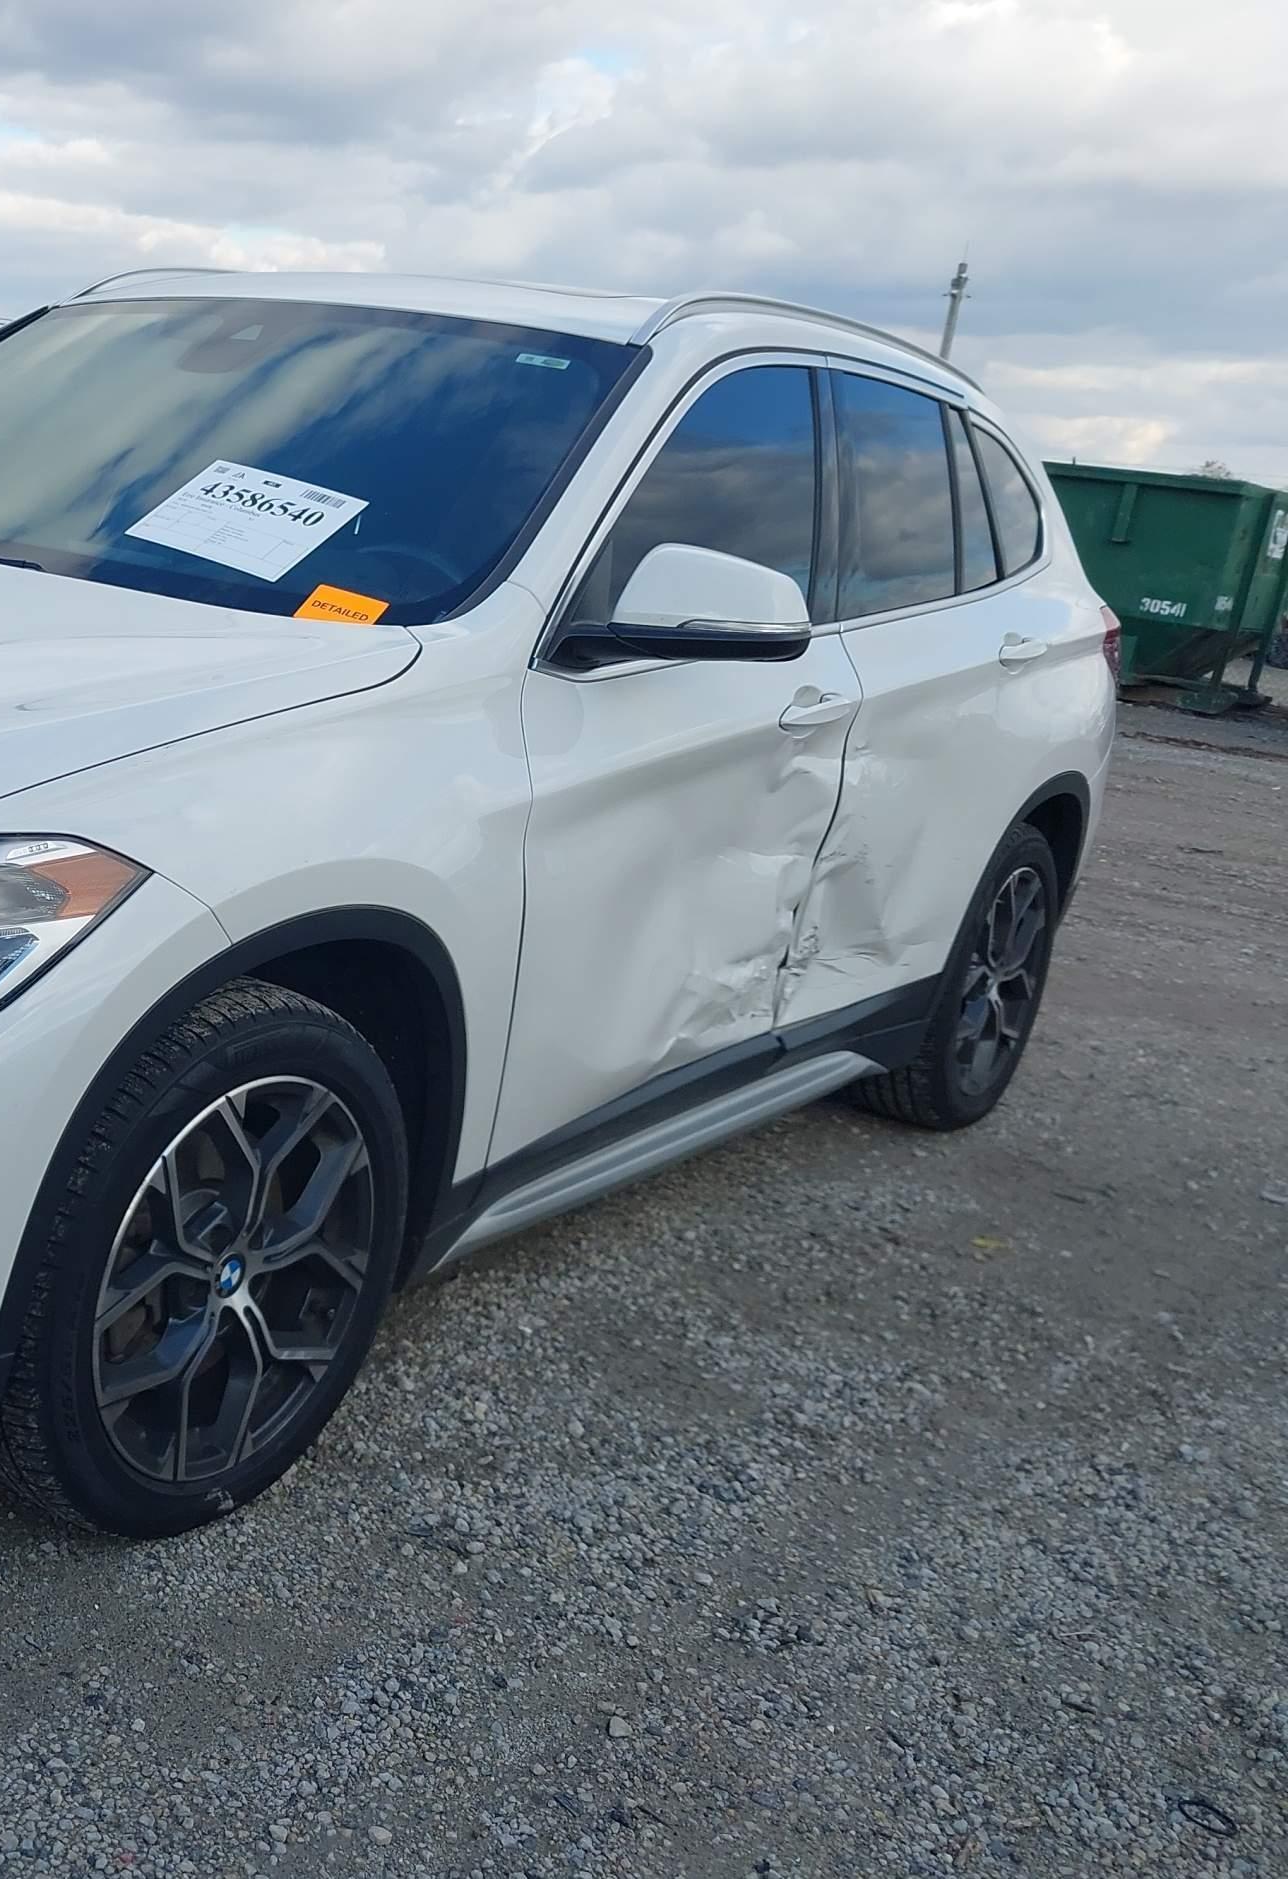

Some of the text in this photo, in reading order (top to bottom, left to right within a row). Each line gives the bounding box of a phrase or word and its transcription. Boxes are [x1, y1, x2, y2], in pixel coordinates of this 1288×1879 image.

[200, 482, 325, 526] 43586540
[311, 600, 369, 621] DETAILED
[1139, 597, 1187, 617] 30541
